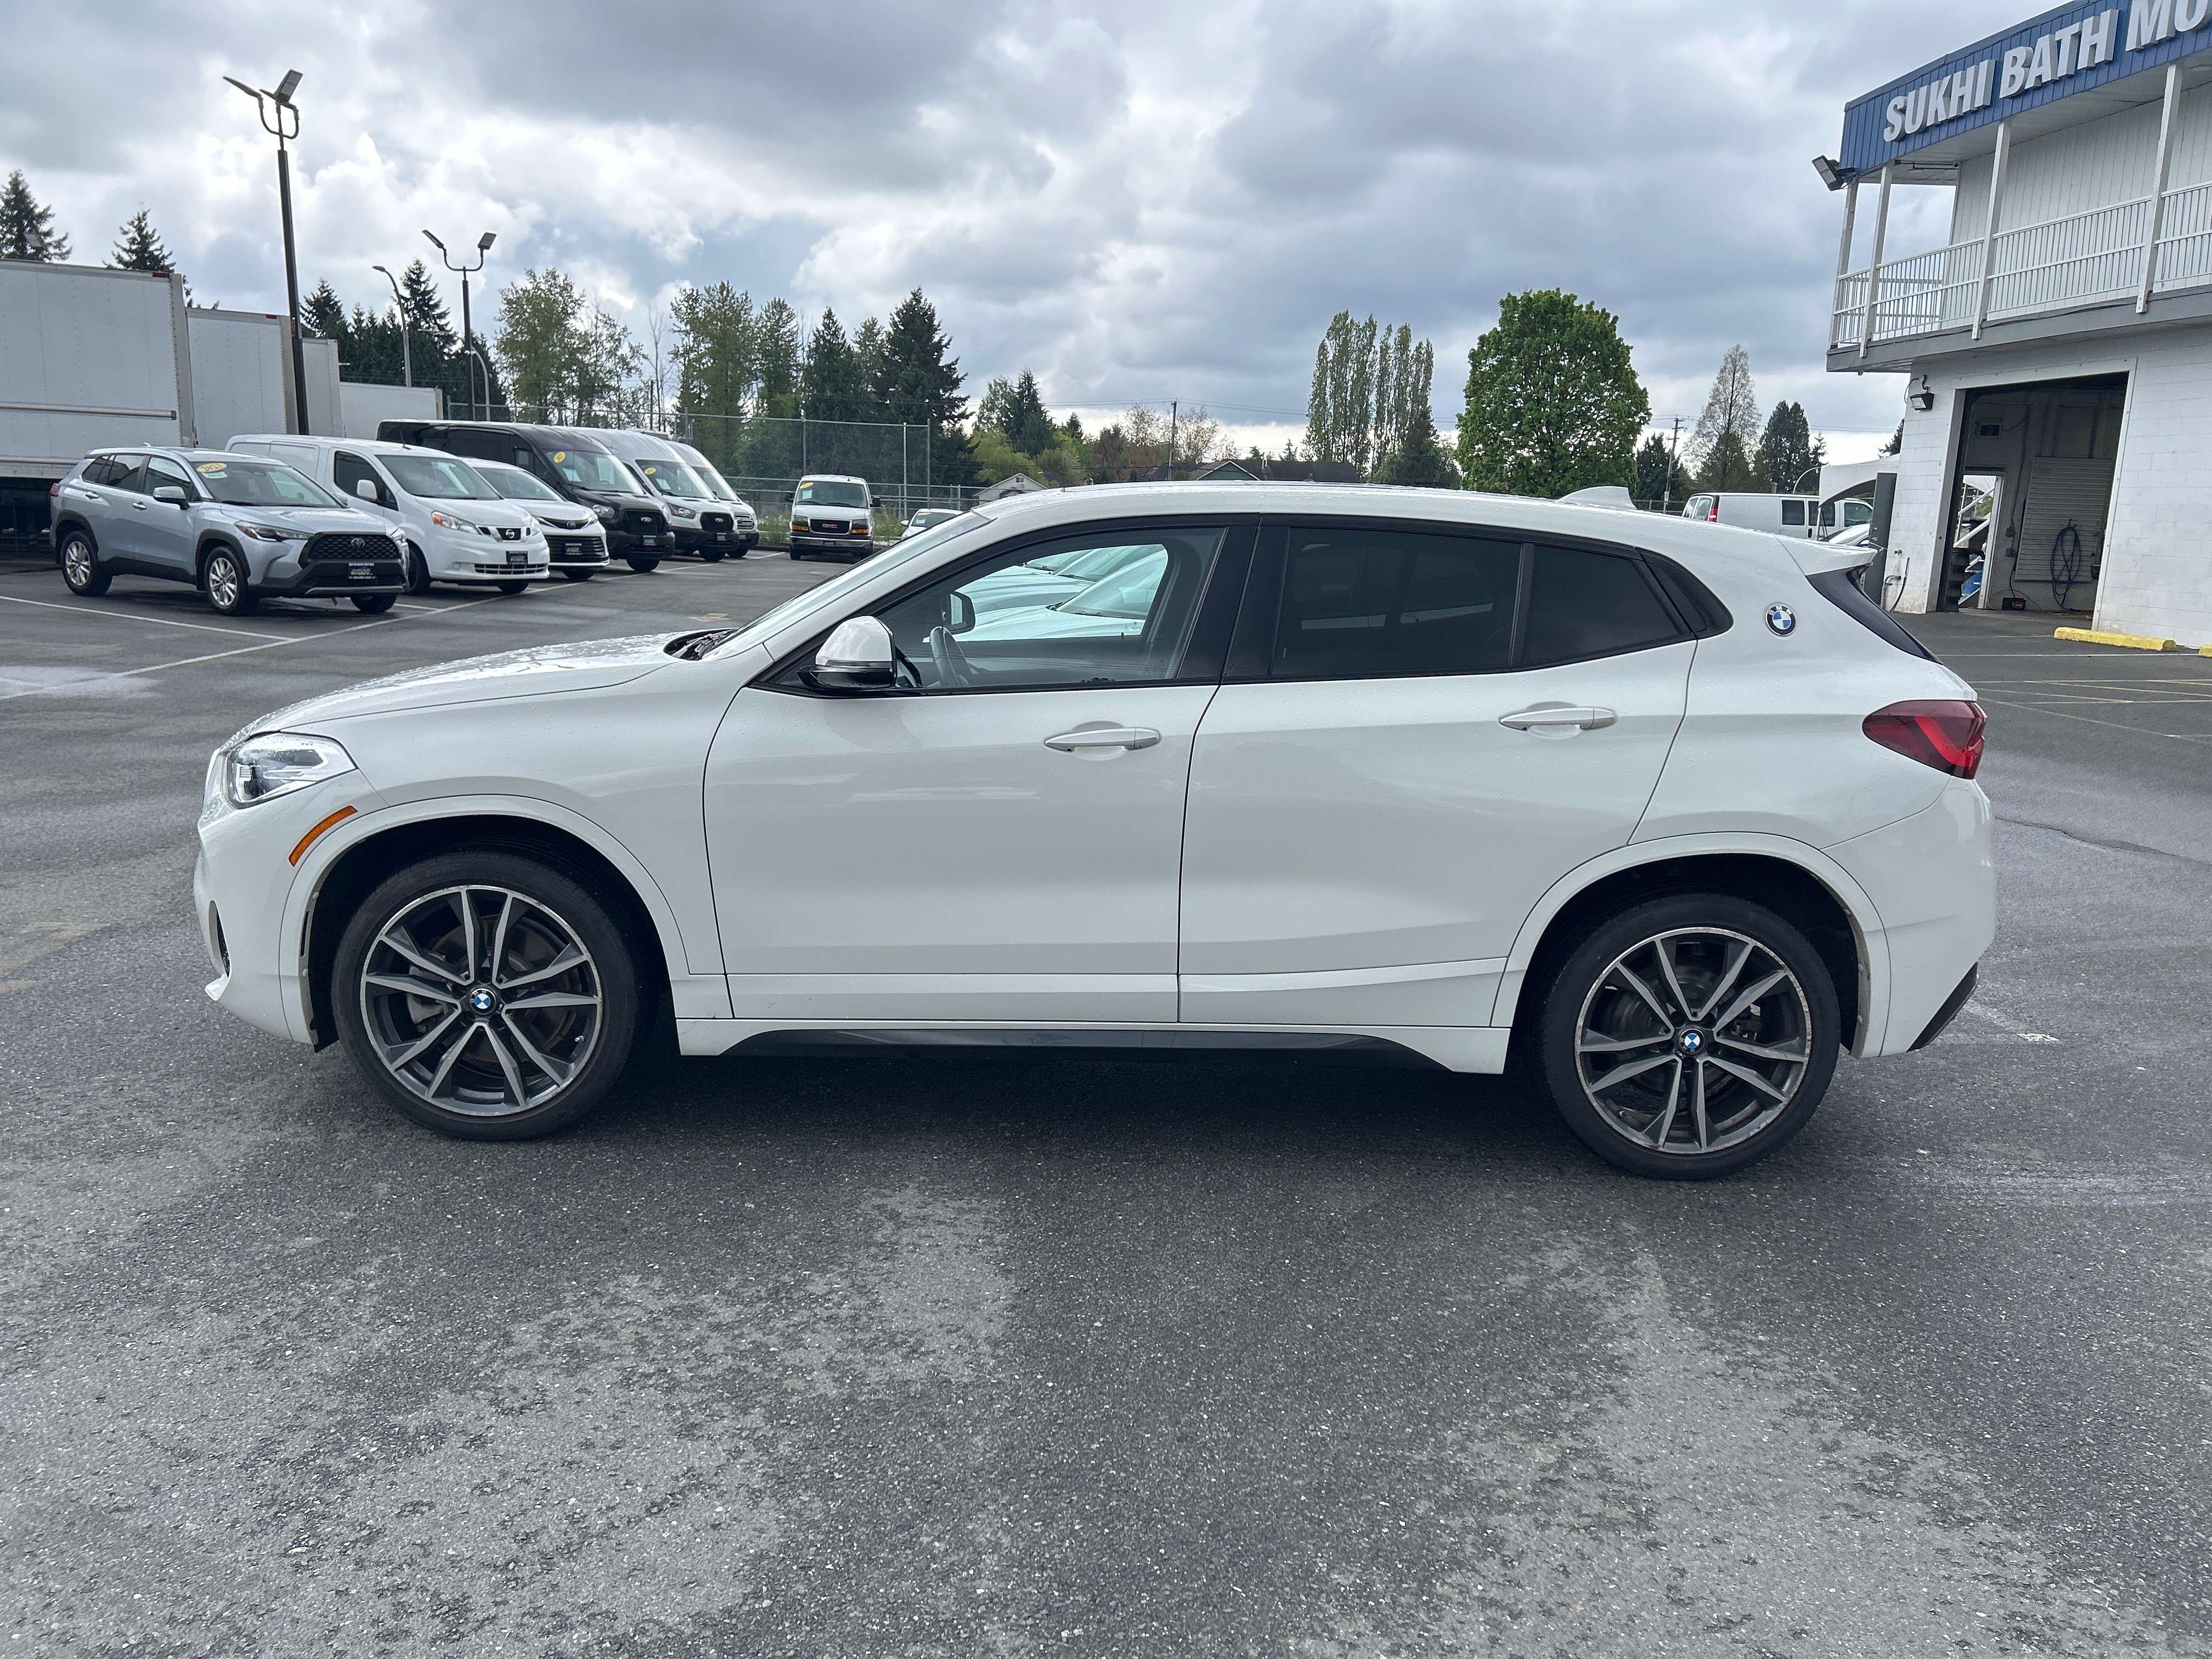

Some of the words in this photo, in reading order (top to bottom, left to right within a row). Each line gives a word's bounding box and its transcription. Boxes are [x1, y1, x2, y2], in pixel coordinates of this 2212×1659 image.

[1884, 59, 1995, 142] SUKHI
[1999, 9, 2119, 99] BATH
[1768, 605, 1793, 615] BMW
